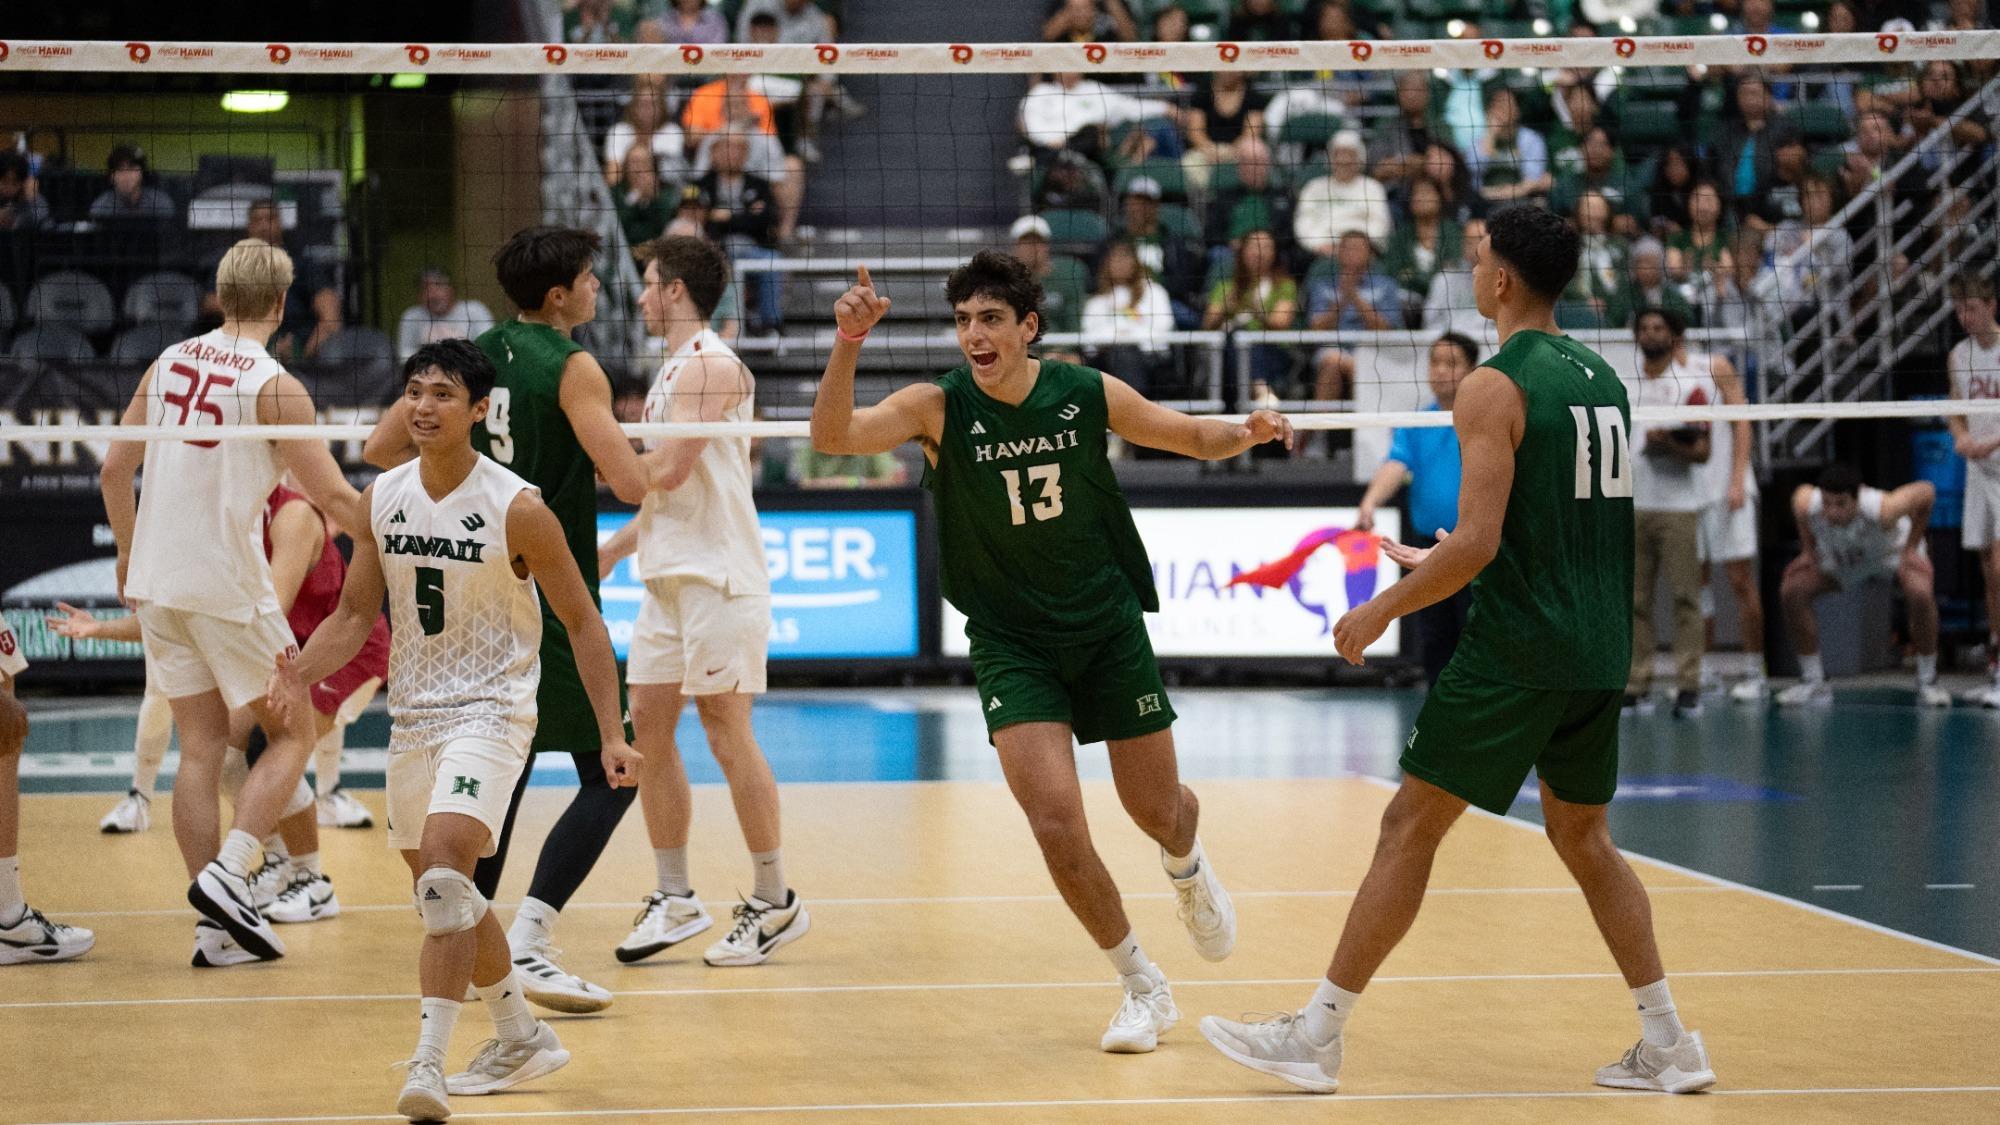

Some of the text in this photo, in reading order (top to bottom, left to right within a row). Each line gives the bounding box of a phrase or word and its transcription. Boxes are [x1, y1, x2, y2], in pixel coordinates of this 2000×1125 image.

[1794, 40, 1825, 48] HAWAII
[1926, 37, 1957, 46] HAWAII
[1400, 46, 1431, 54] HAWAII
[1531, 44, 1562, 52] HAWAII
[1664, 42, 1694, 50] HAWAII
[39, 47, 72, 55] HAWAII
[180, 48, 213, 56] HAWAII
[320, 49, 352, 57] HAWAII
[458, 49, 491, 57] HAWAII
[595, 50, 627, 58] HAWAII
[732, 50, 763, 58] HAWAII
[867, 50, 898, 58] HAWAII
[1001, 49, 1032, 57] HAWAII
[1134, 49, 1166, 57] HAWAII
[1267, 48, 1299, 56] HAWAII
[178, 341, 255, 372] HARVARD
[164, 362, 236, 449] 35
[485, 387, 515, 465] 9
[1568, 405, 1633, 499] 10
[1000, 463, 1063, 525] 13
[415, 566, 445, 636] 5
